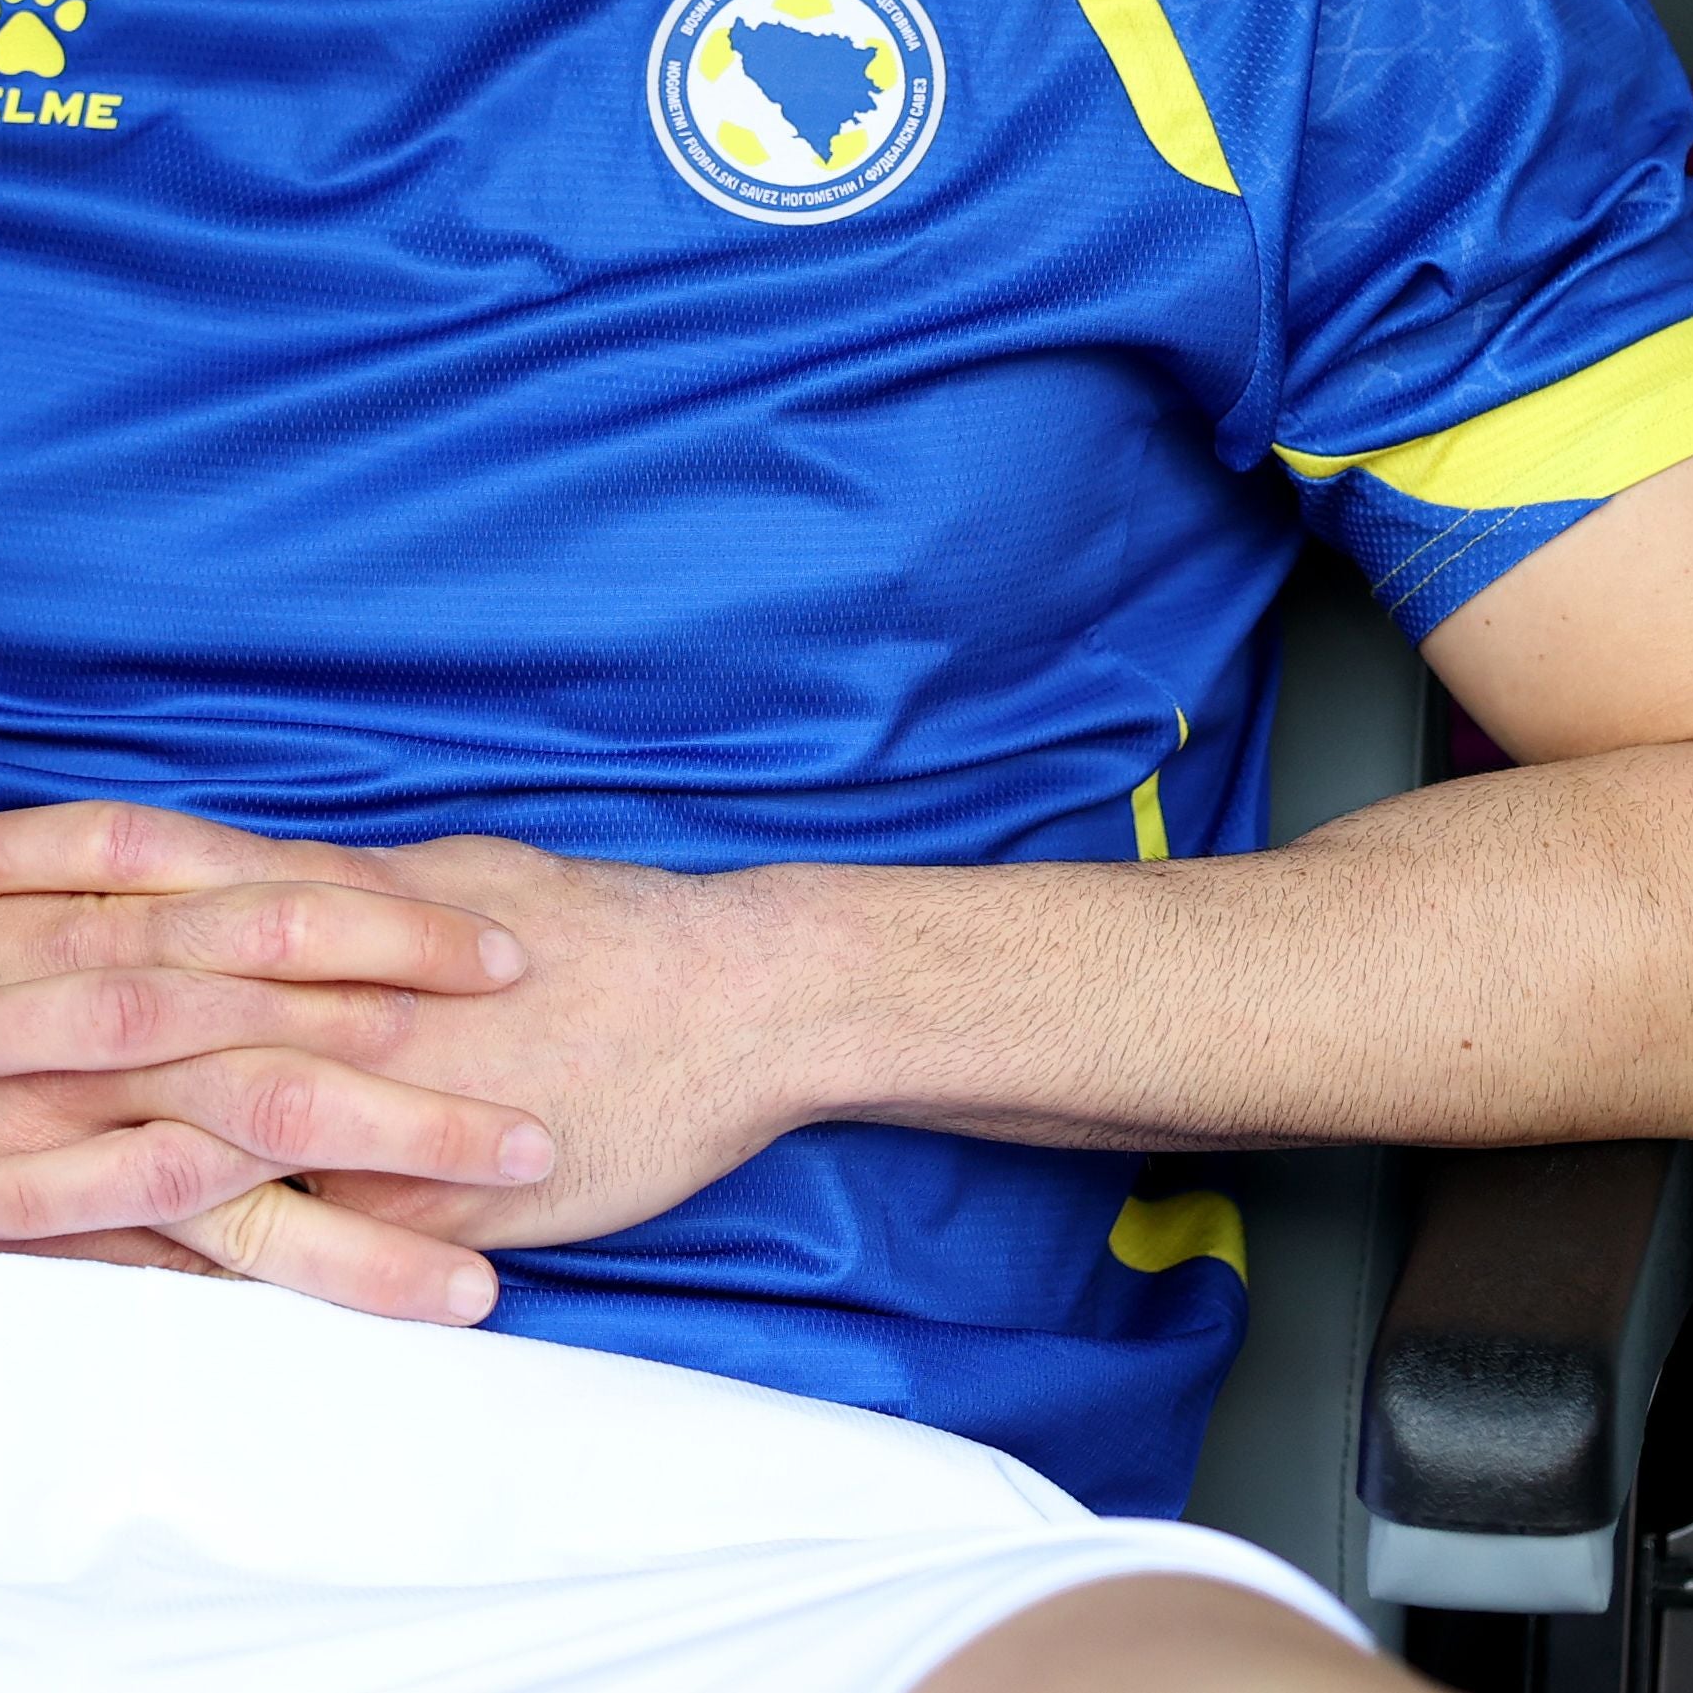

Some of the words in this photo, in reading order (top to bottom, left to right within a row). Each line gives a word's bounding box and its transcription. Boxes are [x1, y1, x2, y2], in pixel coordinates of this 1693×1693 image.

[665, 59, 689, 131] NOGOMETNI
[683, 136, 740, 190] FUDBALSKI
[738, 181, 780, 205] SAVEZ
[780, 179, 859, 207] НОГОМЕТНИ
[864, 116, 921, 181] ФУДБАЛСКИ
[909, 77, 927, 118] САВЕЗ
